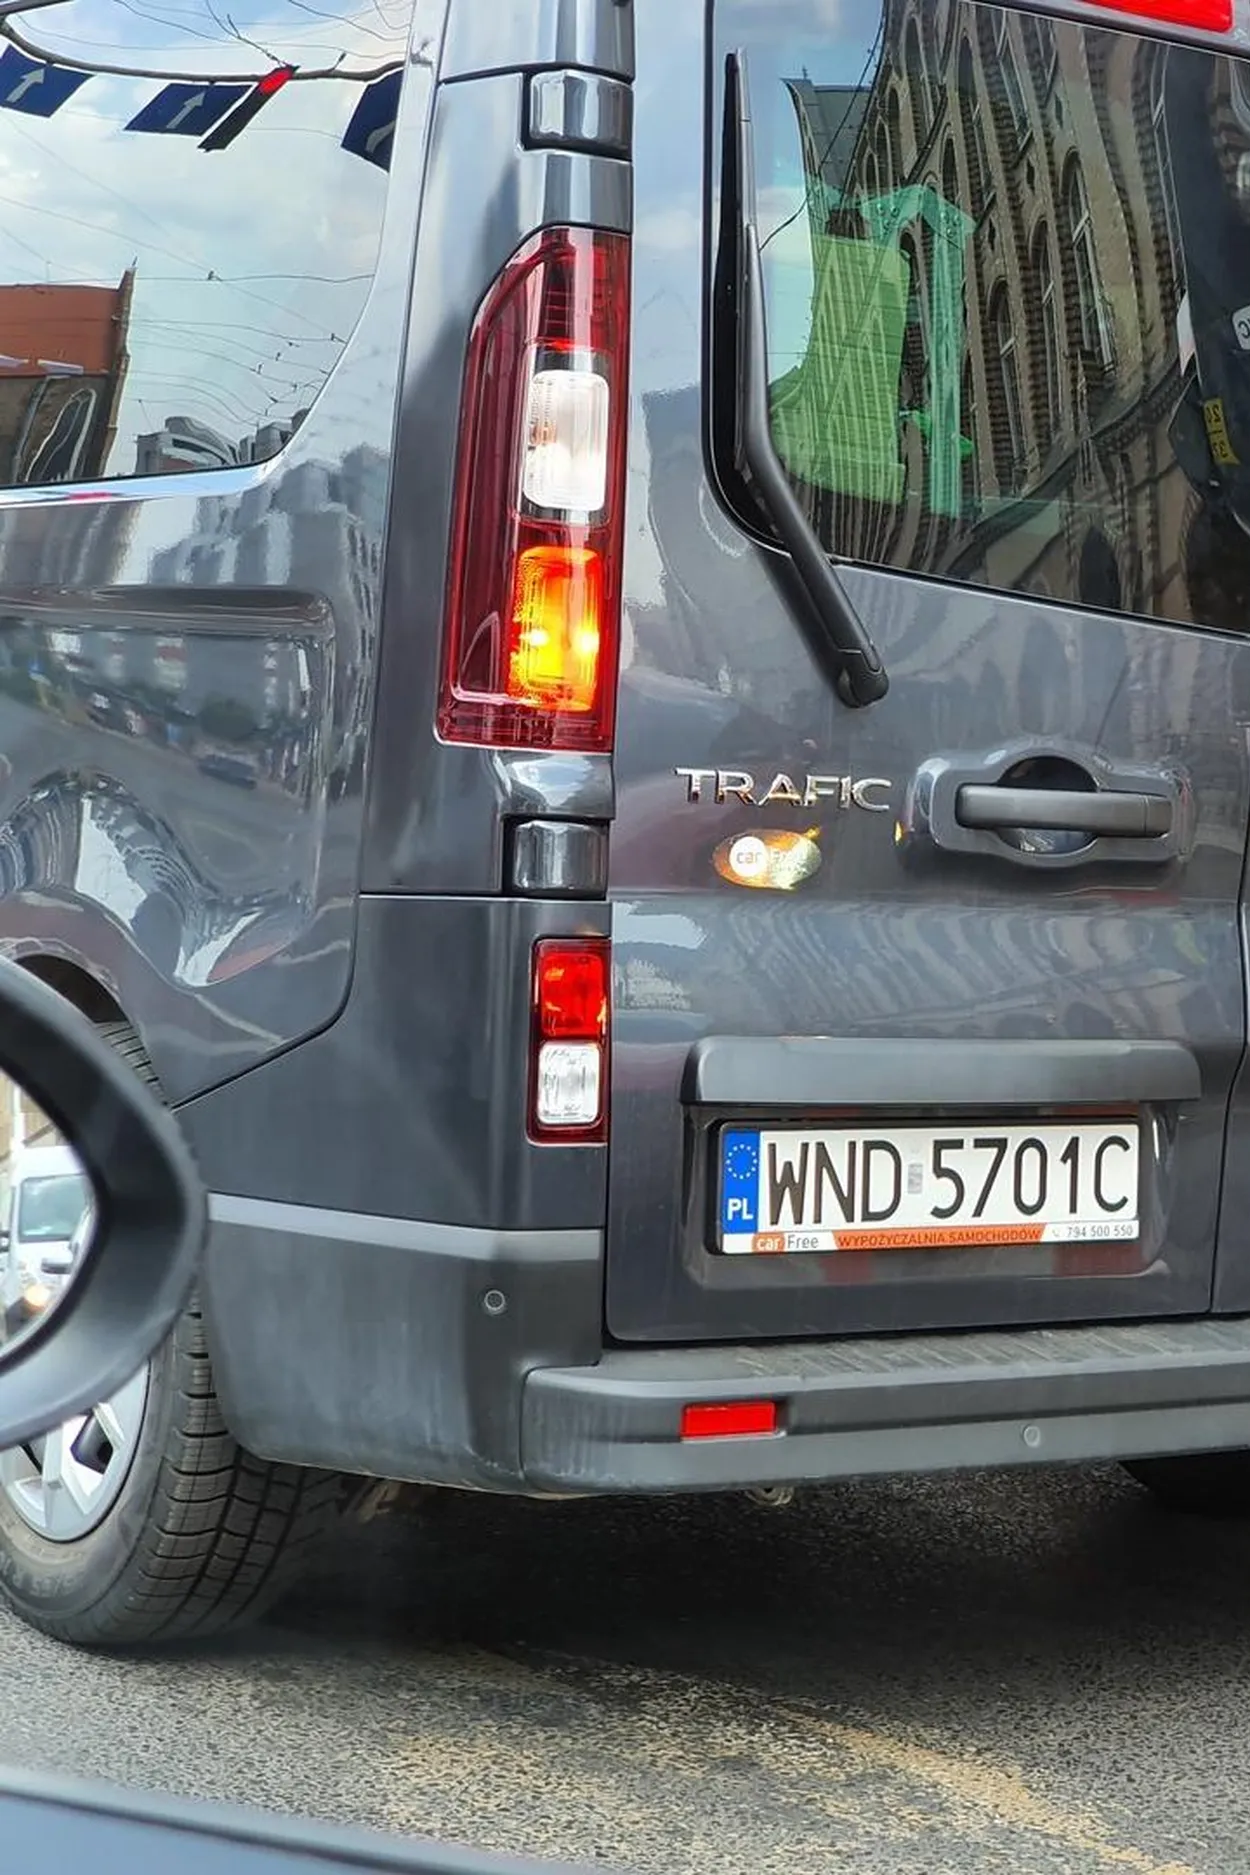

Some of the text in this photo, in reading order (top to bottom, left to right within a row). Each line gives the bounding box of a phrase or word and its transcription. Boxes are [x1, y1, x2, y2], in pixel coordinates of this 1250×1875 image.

[674, 767, 892, 812] TRAFIC
[767, 1135, 1131, 1225] WND 5701C
[727, 1199, 754, 1221] PL
[757, 1234, 819, 1250] car Free
[1067, 1224, 1134, 1238] 794 500 550
